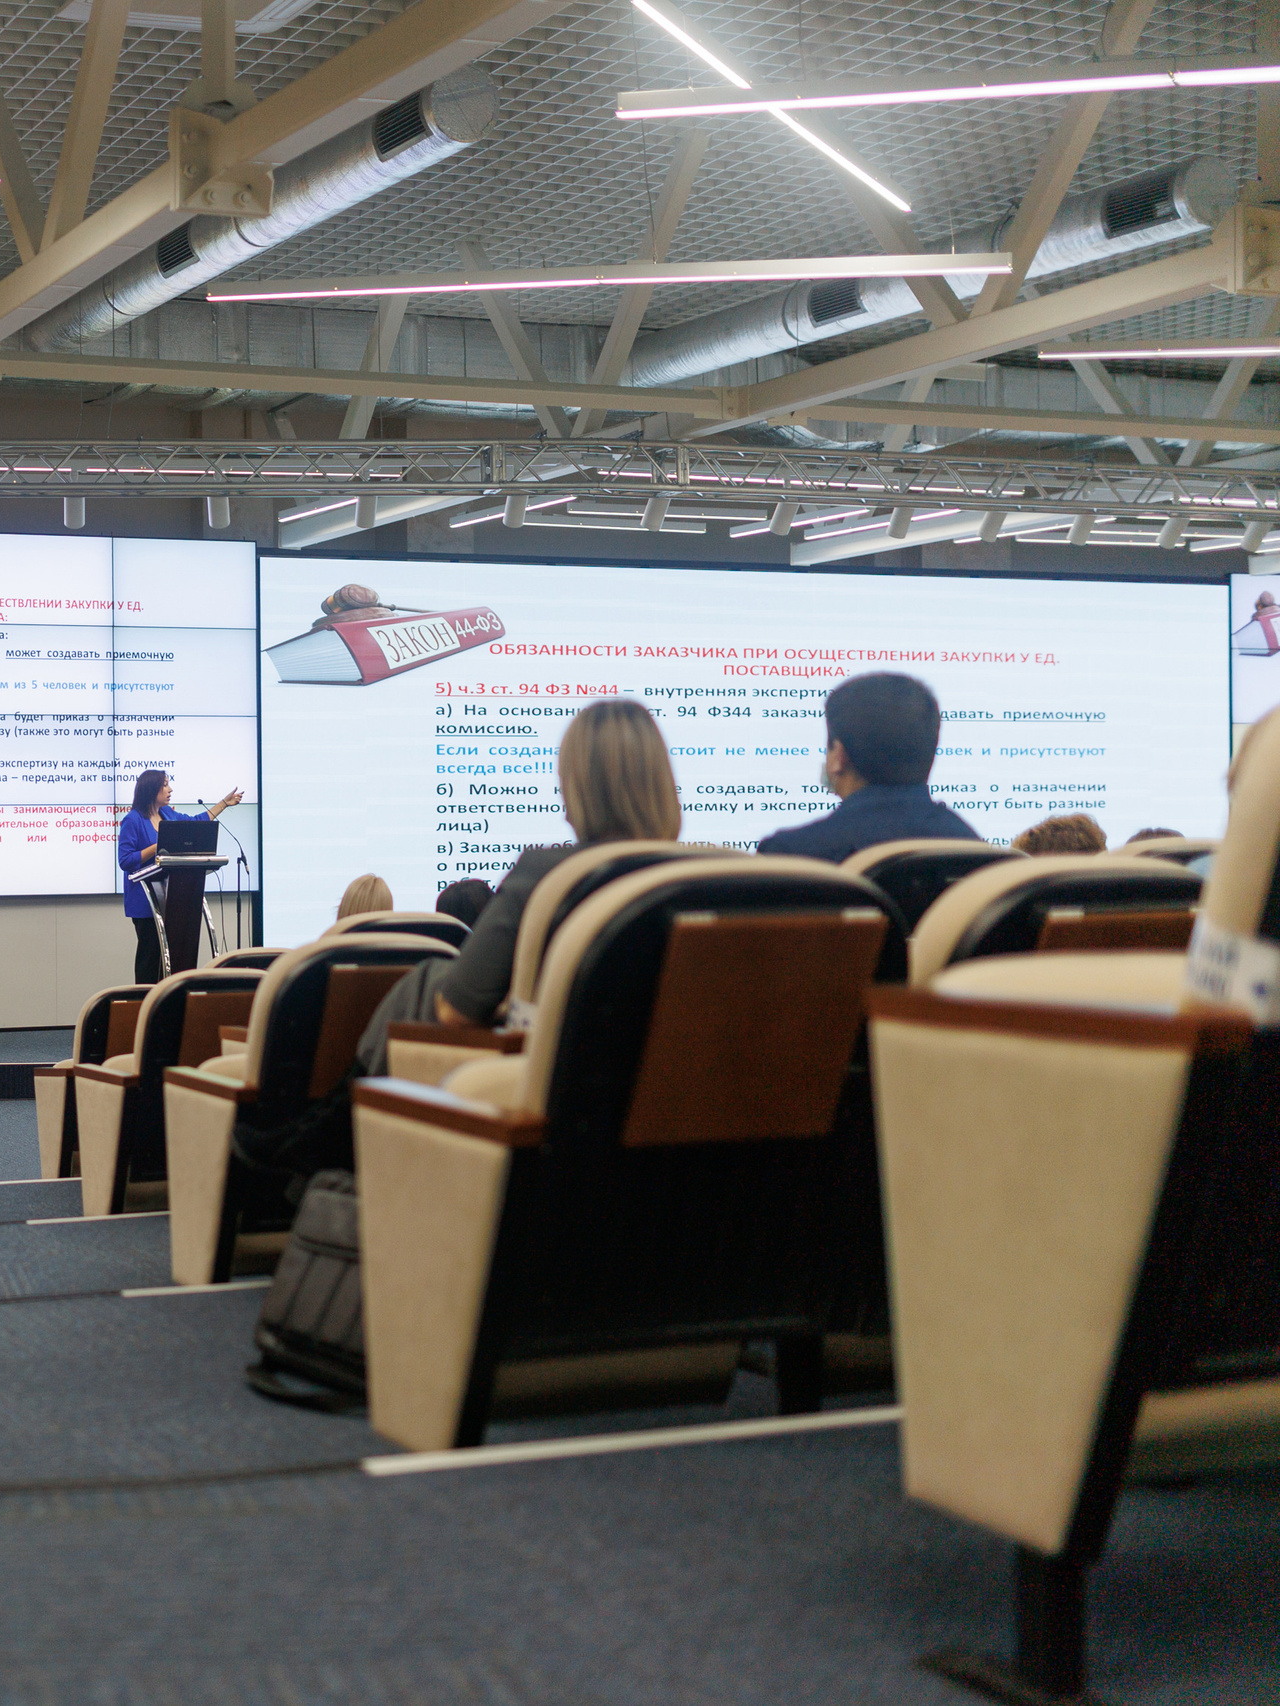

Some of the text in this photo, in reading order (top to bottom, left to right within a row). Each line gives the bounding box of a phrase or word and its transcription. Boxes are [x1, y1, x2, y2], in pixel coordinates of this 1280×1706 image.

[66, 600, 113, 610] ЗАКУПКИ
[128, 602, 144, 612] ЕД.
[376, 611, 502, 662] ЗАКОН 44-ФЗ
[6, 650, 40, 658] может
[47, 651, 100, 660] создавать
[106, 651, 174, 660] приемочную
[490, 643, 1060, 665] ОБЯЗАННОСТИ ЗАКАЗЧИКА ПРИ ОСУЩЕСТВЛЕНИИ ЗАКУПКИ У ЕД.
[724, 665, 850, 678] ПОСТАВЩИКА:
[104, 683, 174, 692] присутствуют
[436, 682, 746, 698] 5) ч.3 ст. 94 ФЗ №44 внутренняя
[436, 704, 1105, 722] а) На 94 приемочную
[15, 727, 50, 737] (также
[74, 728, 104, 737] могут
[108, 726, 133, 736] быть
[136, 728, 174, 738] разные
[436, 725, 537, 734] комиссию.
[436, 744, 478, 755] Если
[726, 747, 745, 756] не
[756, 747, 809, 756] менее
[982, 747, 990, 756] и
[1000, 747, 1106, 758] присутствуют
[0, 760, 58, 769] экспертизу
[78, 758, 120, 769] каждый
[124, 760, 174, 769] документ
[436, 762, 553, 775] всегда все!!!
[22, 774, 76, 784] передачи,
[436, 783, 1106, 797] б) Можно создавать, о назначении
[14, 806, 96, 815] занимающиеся
[745, 798, 1105, 811] и могут быть разные
[436, 819, 489, 833] лица)
[437, 842, 452, 856] в)
[437, 863, 447, 871] о
